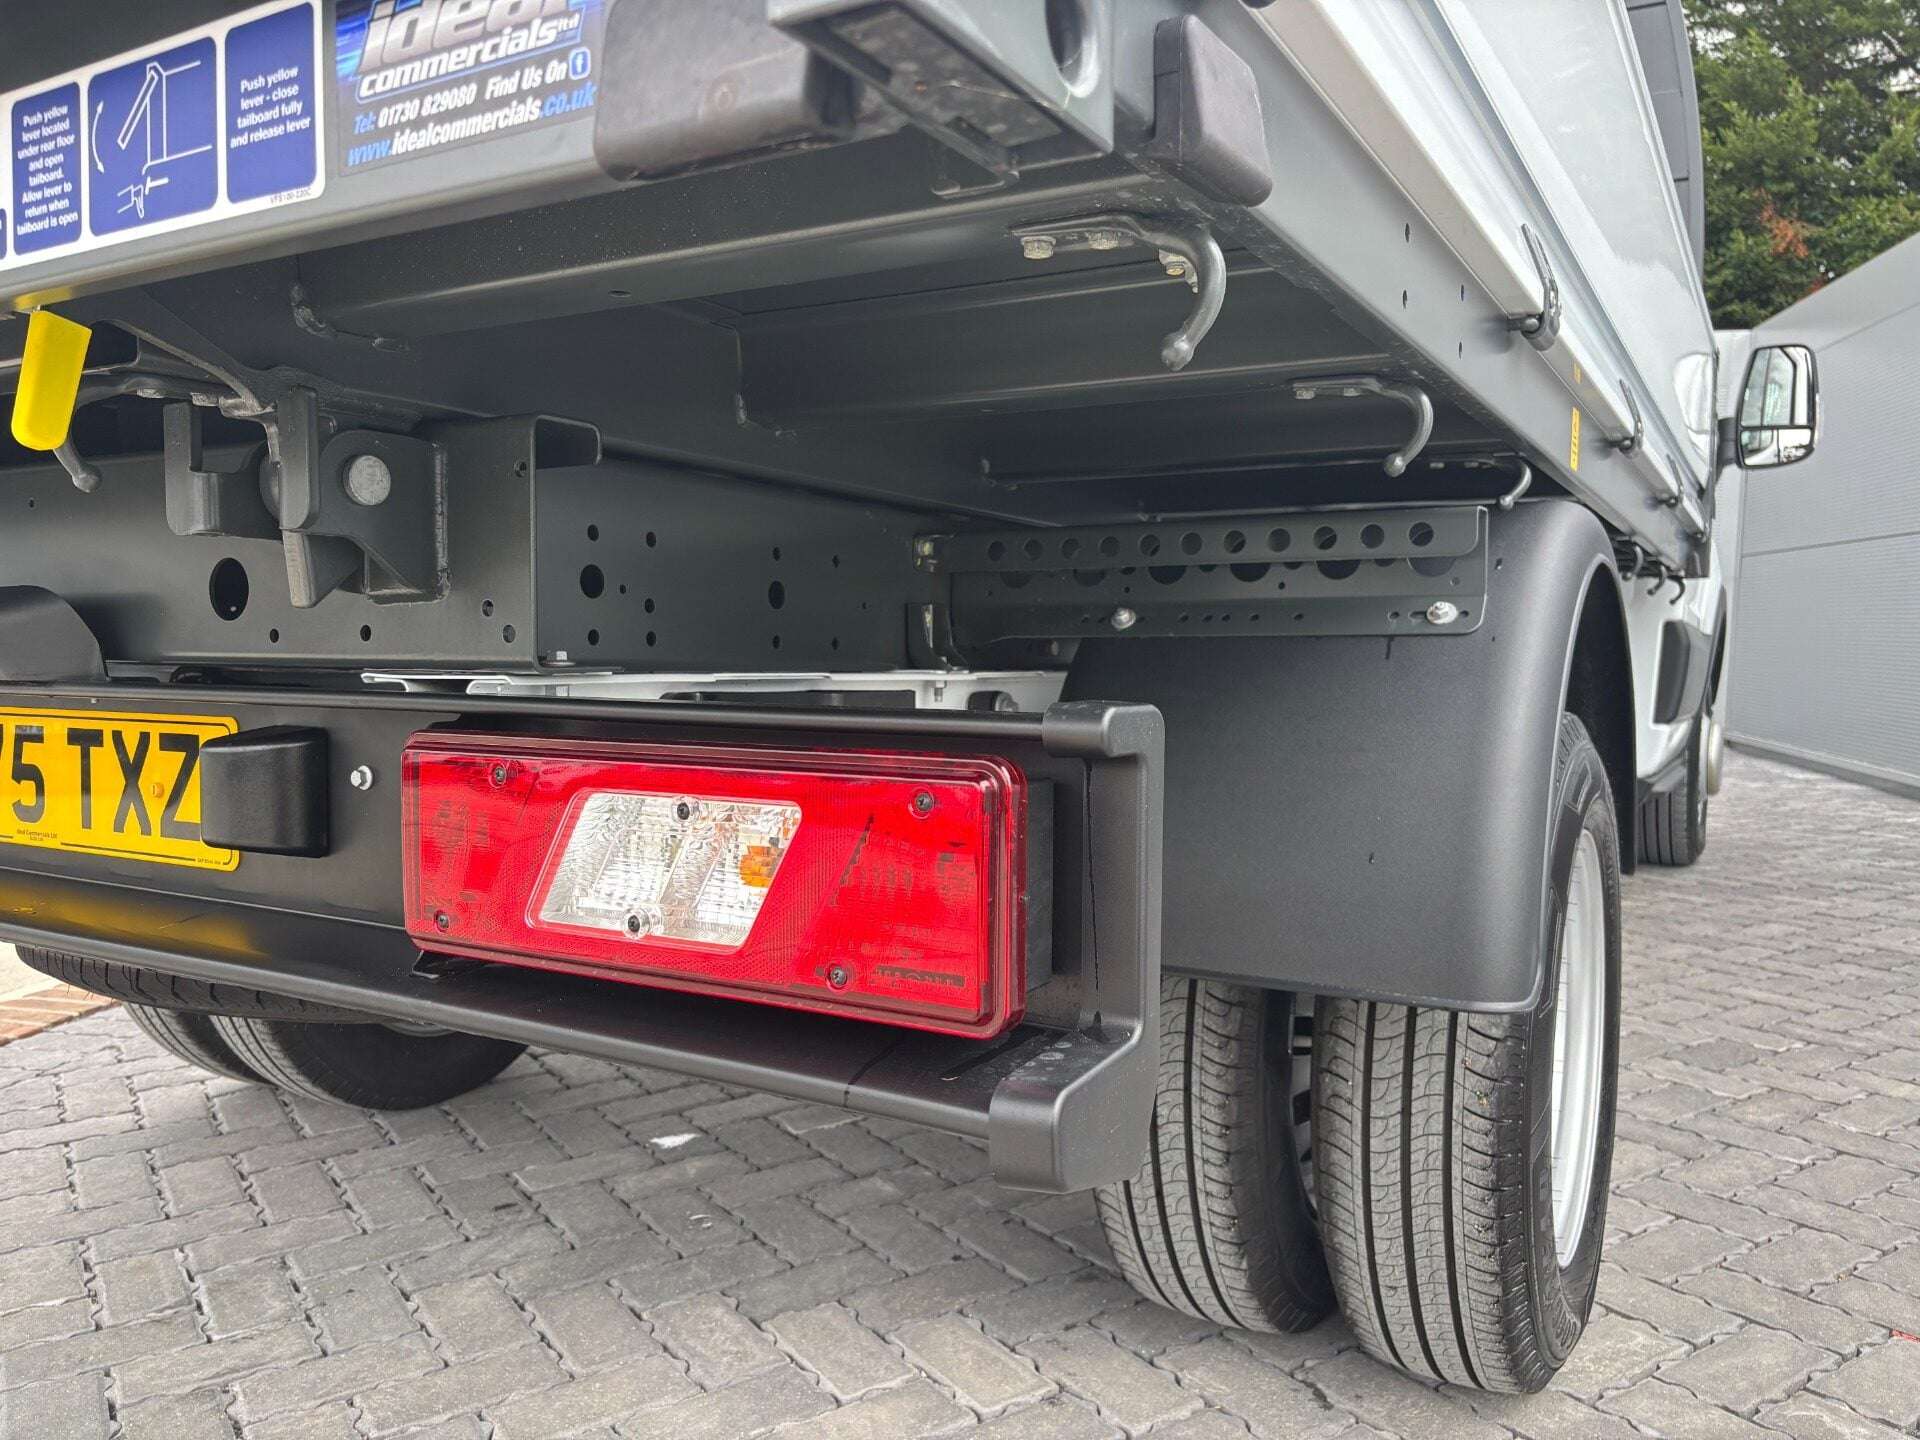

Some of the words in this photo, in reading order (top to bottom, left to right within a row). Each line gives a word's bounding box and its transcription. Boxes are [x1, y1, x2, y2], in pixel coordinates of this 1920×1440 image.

[358, 0, 572, 73] idea
[359, 18, 558, 98] commercials
[240, 75, 265, 93] Push
[267, 66, 299, 87] yellow
[240, 95, 264, 111] lever
[272, 84, 299, 101] close
[353, 113, 377, 134] Tel:
[378, 97, 421, 129] 01730
[421, 83, 477, 117] 829080
[485, 70, 519, 100] Find
[521, 65, 543, 88] Us
[545, 59, 568, 83] On
[23, 111, 43, 128] Push
[43, 104, 69, 123] yellow
[237, 105, 279, 129] tailboard
[281, 100, 303, 116] fully
[348, 81, 598, 167] www.idealcommercials.co.uk
[22, 129, 41, 143] lever
[41, 117, 70, 137] located
[230, 132, 249, 149] and
[250, 125, 285, 143] release
[286, 117, 311, 134] lever
[17, 143, 40, 160] under
[40, 140, 56, 153] rear
[56, 133, 75, 148] floor
[28, 156, 43, 172] and
[44, 152, 64, 169] open
[21, 191, 43, 205] Allow
[43, 184, 63, 200] lever
[63, 180, 73, 193] to
[24, 205, 48, 219] return
[48, 197, 70, 212] when
[16, 217, 49, 236] tailboard
[49, 214, 58, 228] is
[58, 210, 79, 227] open
[67, 727, 200, 842] TXZ
